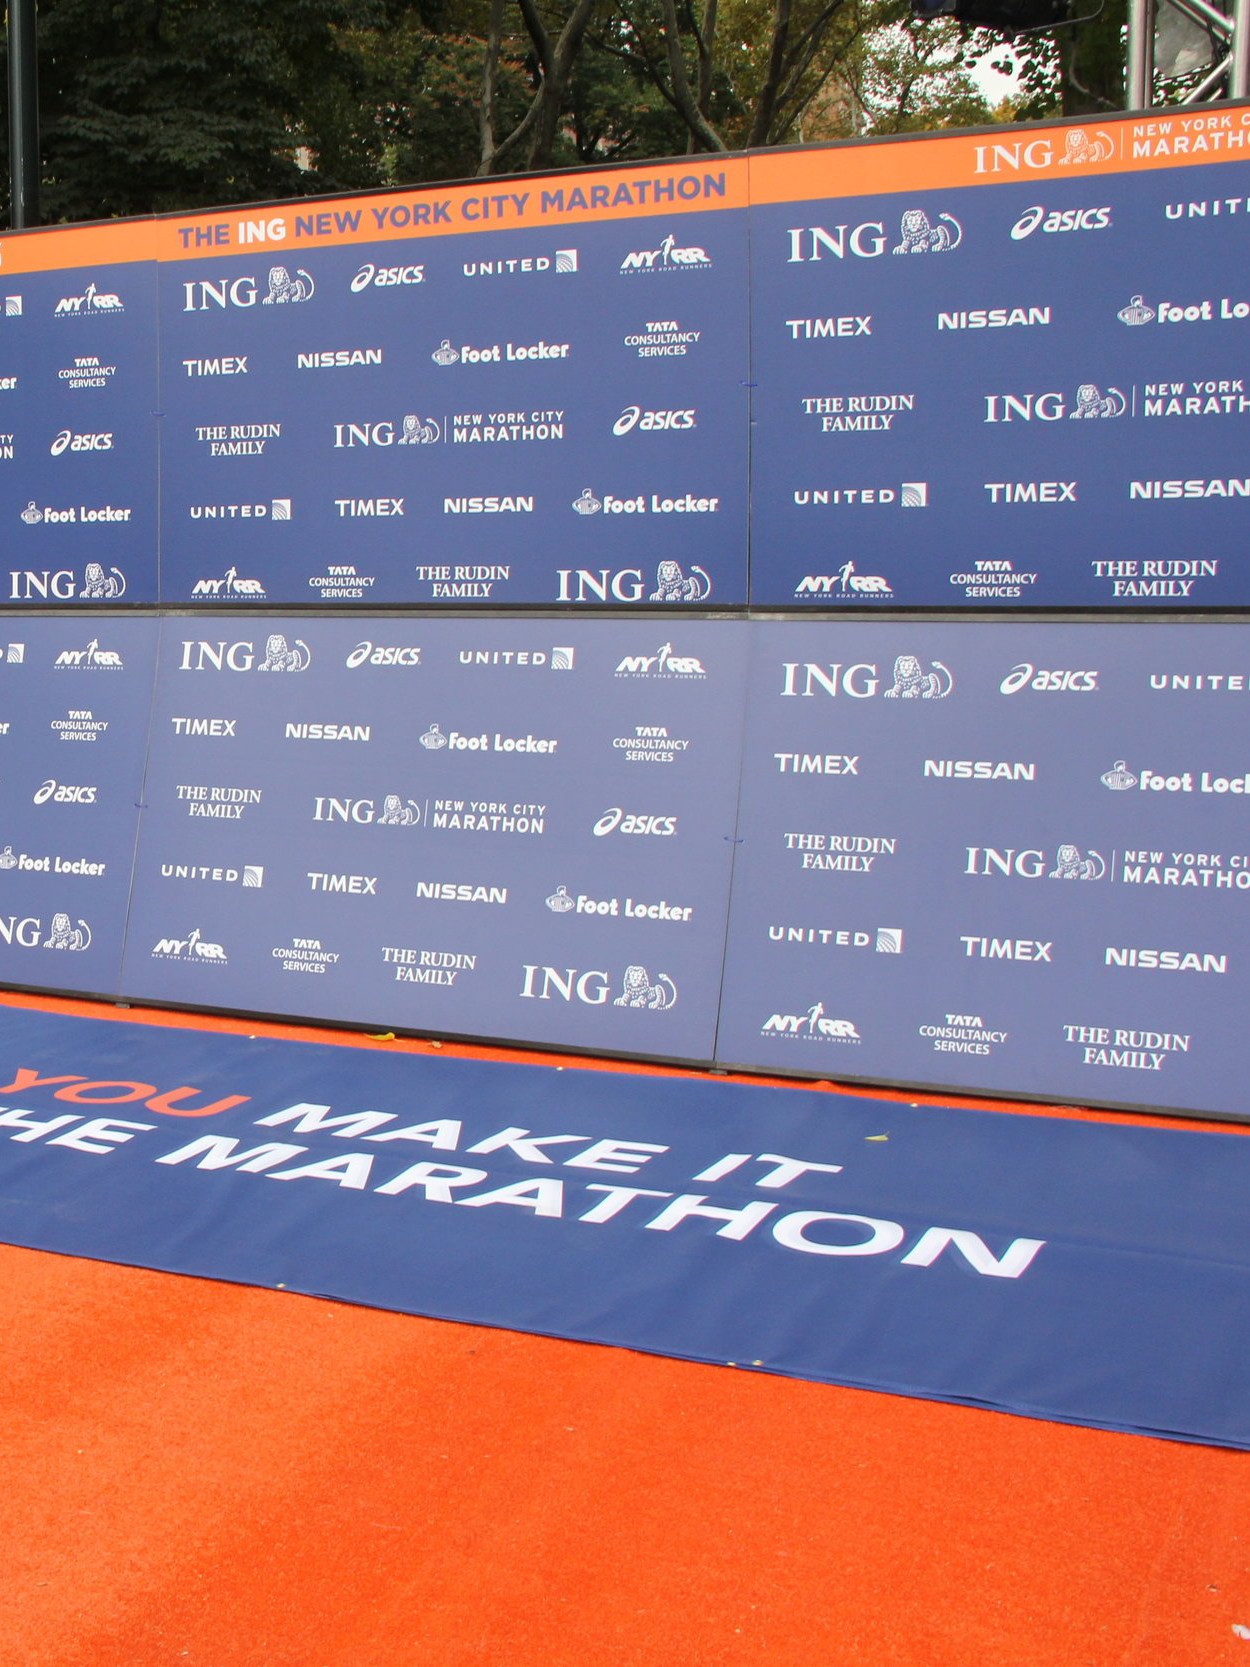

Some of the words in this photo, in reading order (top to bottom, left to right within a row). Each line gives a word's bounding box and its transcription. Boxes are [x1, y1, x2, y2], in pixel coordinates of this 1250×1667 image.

[1134, 123, 1169, 137] NEW
[1182, 116, 1231, 131] YORK
[1133, 128, 1250, 158] MARATH
[975, 140, 1053, 173] ING
[178, 224, 230, 248] THE
[239, 218, 286, 243] ING
[296, 210, 362, 237] NEW
[372, 201, 451, 229] YORK
[461, 193, 529, 221] CITY
[540, 171, 728, 214] MARATHON
[1166, 198, 1250, 219] UNIT
[788, 222, 886, 262] ING
[464, 258, 549, 276] UNITED
[183, 277, 258, 311] ING
[938, 307, 1049, 329] NISSAN
[1158, 301, 1212, 323] Foot
[646, 321, 678, 332] TATA
[786, 316, 871, 338] TIMEX
[625, 330, 700, 347] CONSULTANCY
[462, 346, 500, 363] Foot
[507, 342, 569, 360] Locker
[636, 342, 686, 357] SERVICES
[454, 415, 482, 425] NEW
[489, 413, 524, 424] YORK
[532, 411, 563, 422] CITY
[334, 423, 394, 447] ING
[454, 422, 562, 442] MARATHON
[795, 490, 894, 504] UNITED
[1130, 479, 1250, 498] NISSAN
[444, 497, 533, 513] NISSAN
[975, 561, 1011, 571] TATA
[1092, 561, 1137, 576] THE
[1143, 560, 1217, 576] RUDIN
[10, 571, 76, 598] ING
[950, 574, 1036, 584] CONSULTANCY
[1113, 581, 1193, 596] FAMILY
[966, 587, 1020, 597] SERVICES
[460, 651, 545, 664] UNITED
[781, 664, 879, 697] ING
[1151, 675, 1250, 690] UNITE
[449, 733, 487, 750] Foot
[495, 734, 557, 753] Locker
[1140, 771, 1192, 791] Foot
[1202, 773, 1250, 793] Loc
[313, 798, 374, 823] ING
[435, 800, 464, 811] NEW
[471, 802, 506, 813] YORK
[513, 804, 545, 815] CITY
[434, 813, 543, 833] MARATHON
[784, 833, 825, 850] THE
[830, 836, 895, 853] RUDIN
[803, 854, 874, 871] FAMILY
[946, 1015, 982, 1027] TATA
[920, 1024, 1006, 1044] CONSULTANCY
[934, 1039, 990, 1054] SERVICES
[252, 1103, 669, 1177] MAKE
[692, 1153, 842, 1189] IT
[154, 1131, 1046, 1281] MARATHON
